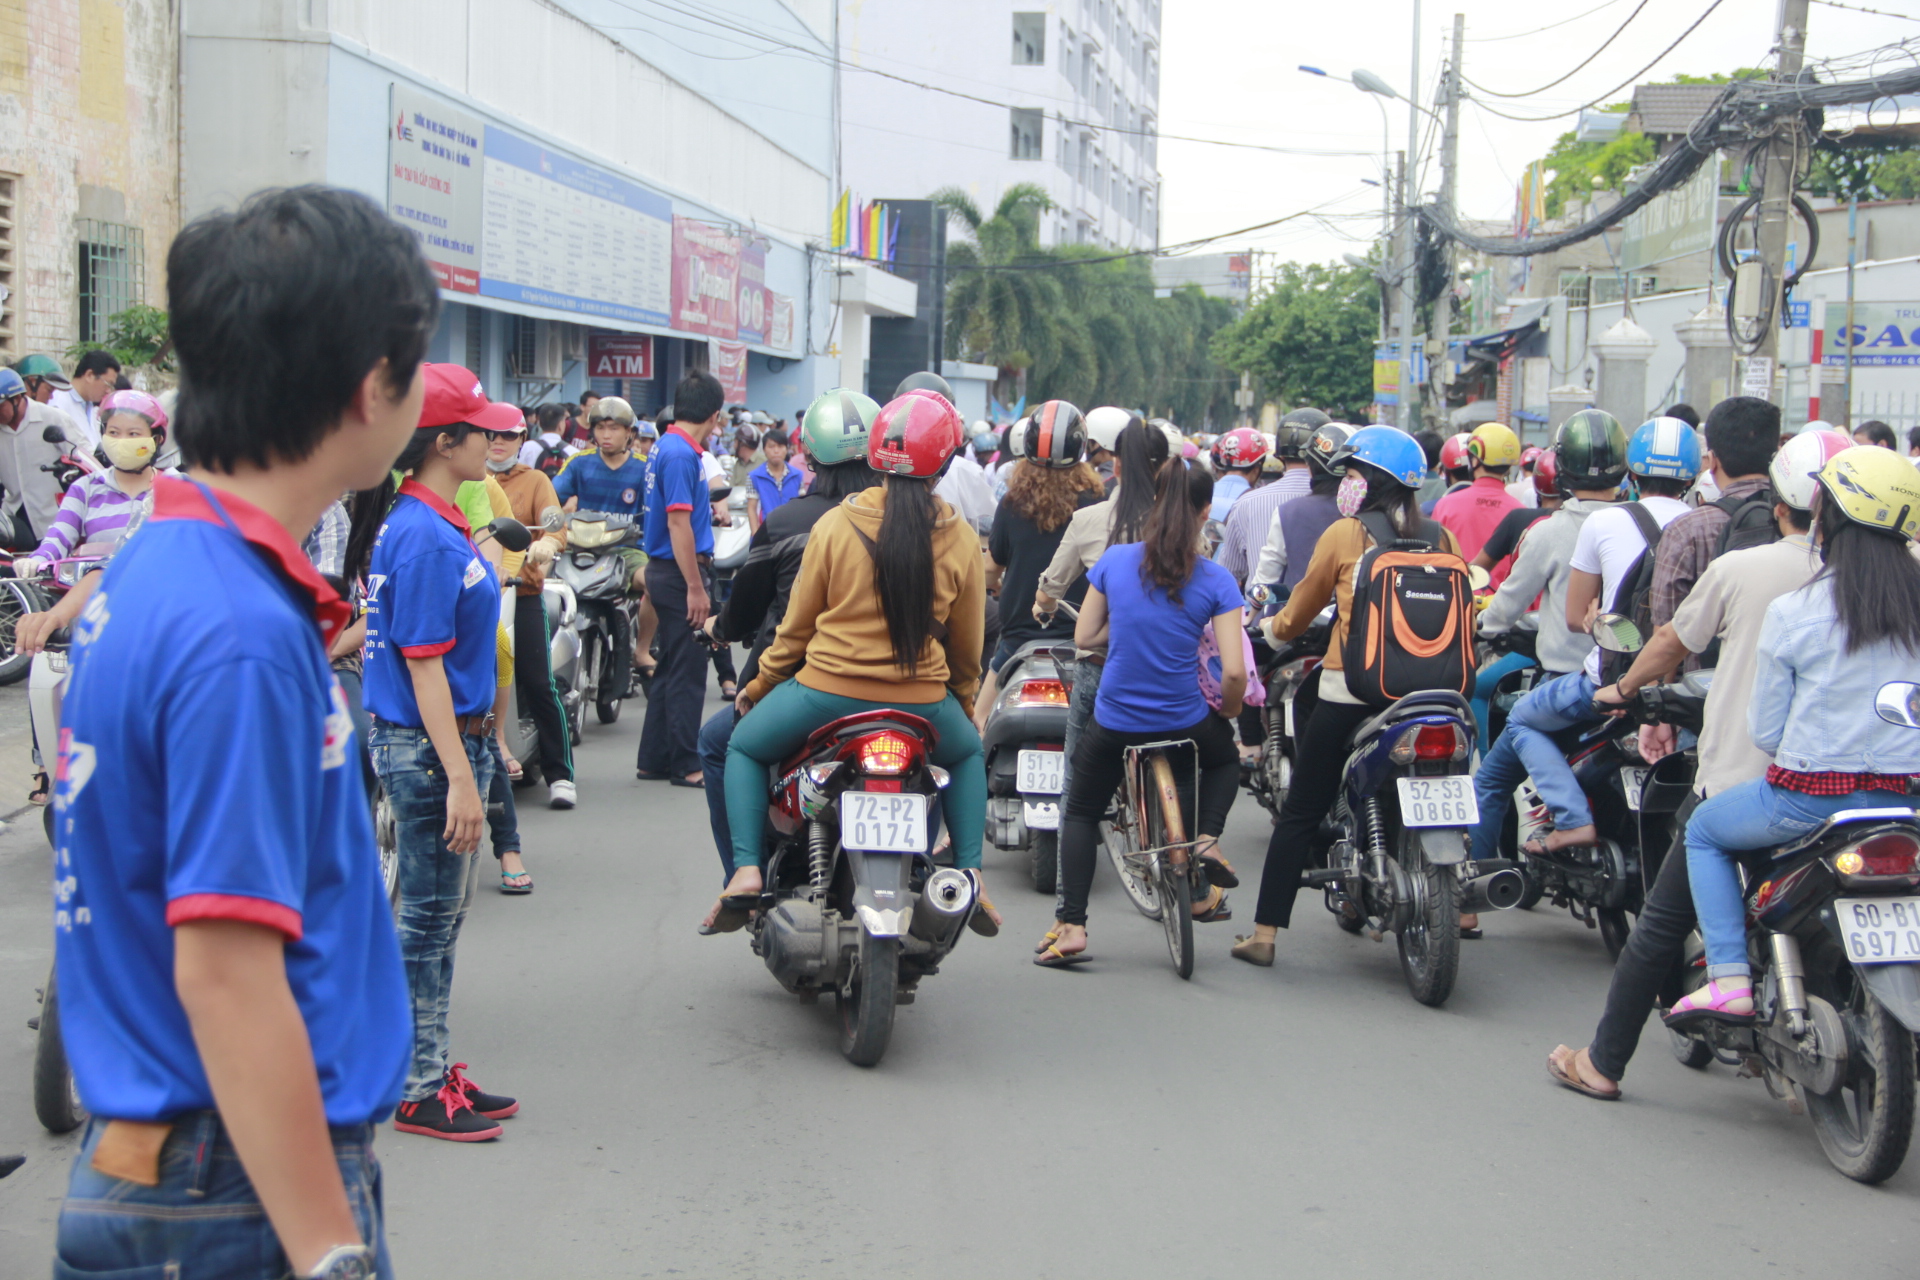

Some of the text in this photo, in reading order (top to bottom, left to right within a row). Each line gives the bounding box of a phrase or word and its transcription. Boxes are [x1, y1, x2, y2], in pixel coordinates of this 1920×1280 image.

[597, 355, 644, 374] ATM
[1475, 497, 1502, 508] SPORT
[1405, 590, 1445, 600] Sacombank
[1027, 753, 1064, 772] 51-Y
[1026, 772, 1061, 790] 920
[1633, 769, 1649, 787] 6
[1409, 780, 1463, 801] 52-S3
[854, 795, 914, 822] 72-P2
[1413, 801, 1467, 821] 0866
[855, 821, 915, 848] 0174
[1852, 902, 1920, 929] 60-B1
[1850, 930, 1920, 958] 697.0
